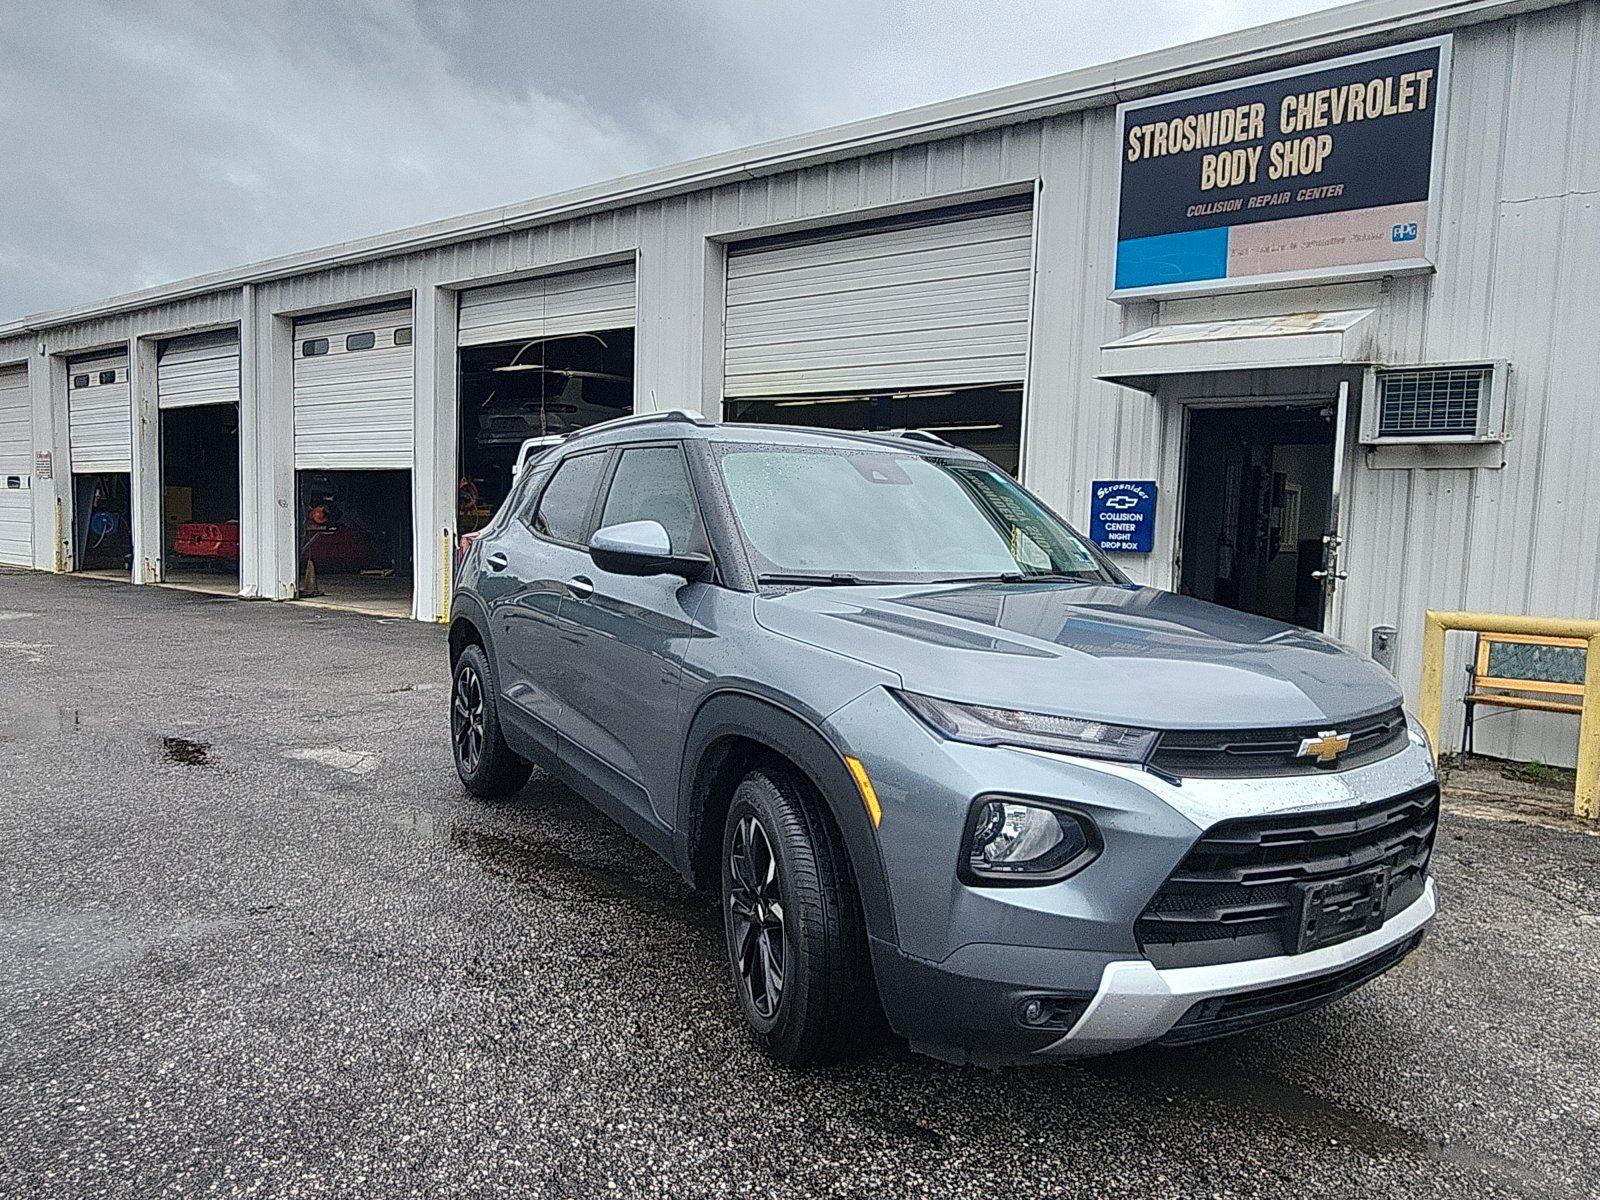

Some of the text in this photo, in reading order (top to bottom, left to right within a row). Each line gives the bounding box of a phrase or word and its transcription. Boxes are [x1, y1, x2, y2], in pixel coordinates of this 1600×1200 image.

[1128, 69, 1433, 161] STROSNIDER CHEVROLET
[1201, 135, 1332, 190] BODY SHOP
[1187, 184, 1344, 217] COLLISION REPAIR CENTER
[1393, 223, 1416, 239] PPG
[1097, 484, 1149, 499] Strosnider
[1100, 513, 1143, 521] COLLISION
[1105, 523, 1136, 531] CENTER
